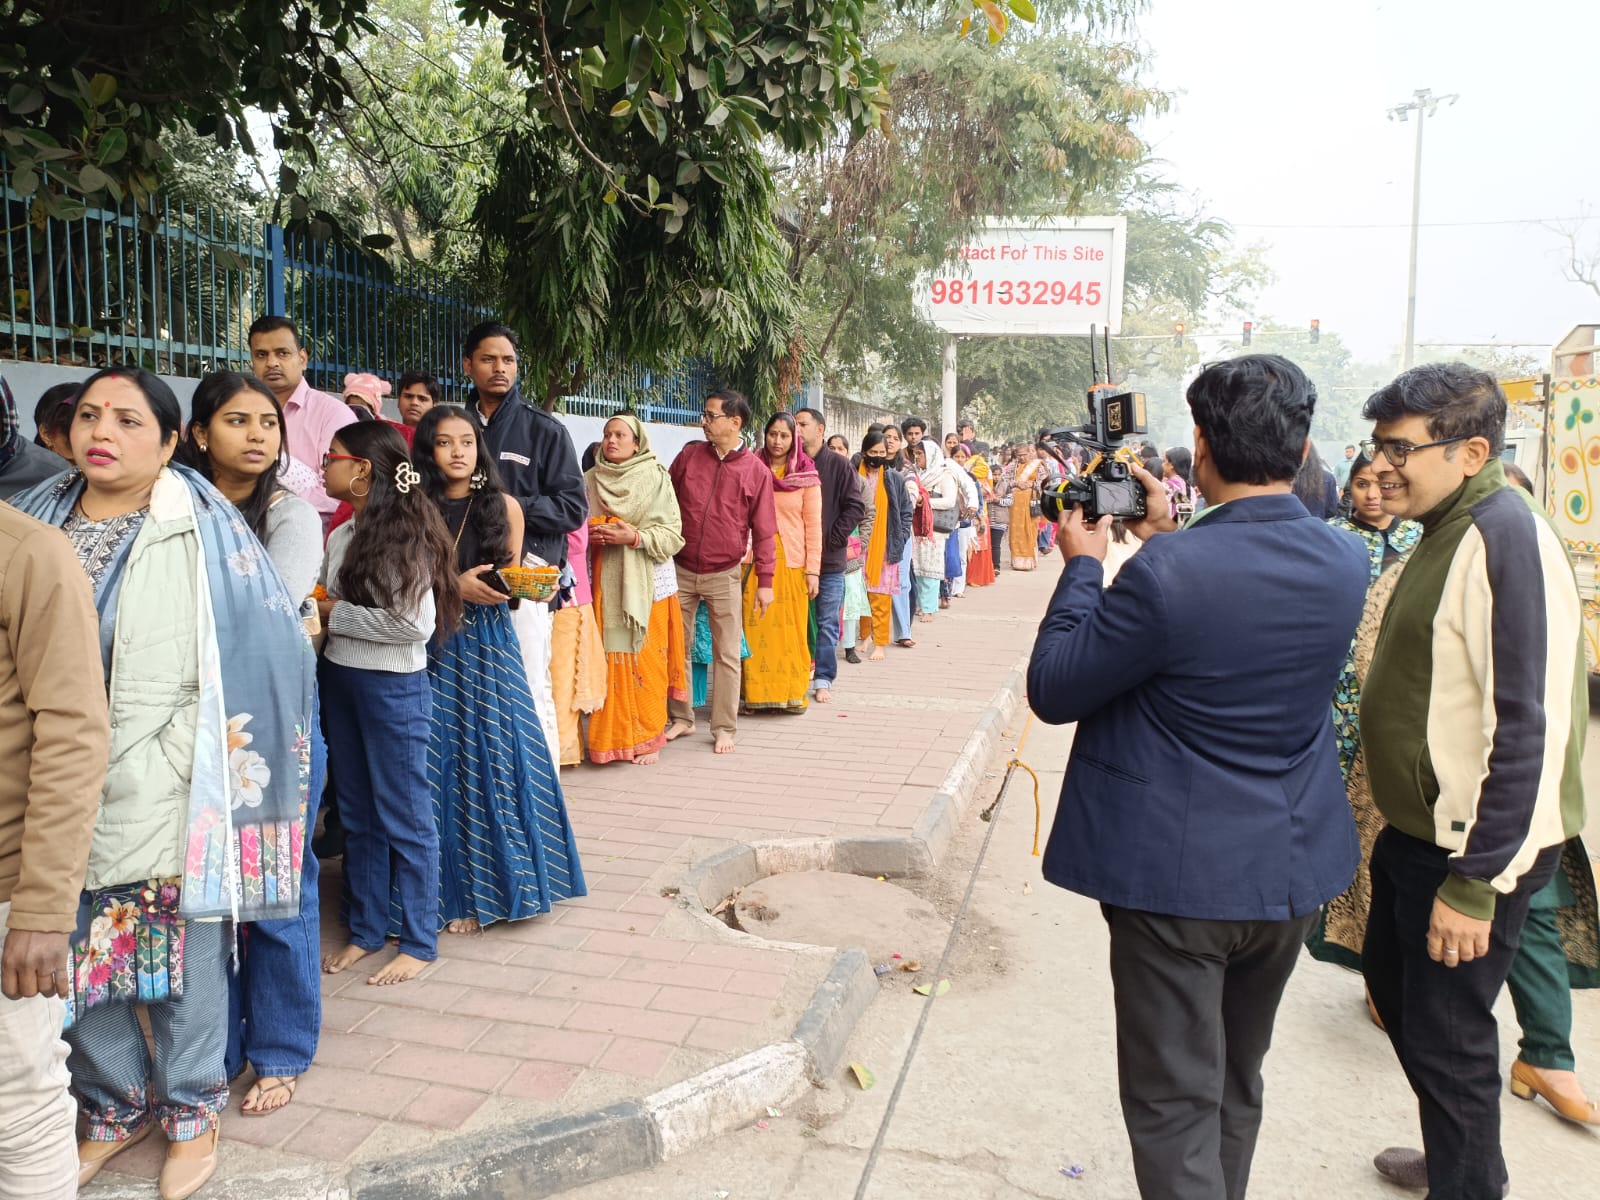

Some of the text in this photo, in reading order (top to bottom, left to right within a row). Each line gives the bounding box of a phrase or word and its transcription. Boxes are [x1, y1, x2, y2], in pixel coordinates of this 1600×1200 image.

[1000, 245, 1028, 261] For
[1033, 245, 1067, 261] This
[1073, 245, 1104, 261] Site
[931, 279, 1101, 306] 9811332945
